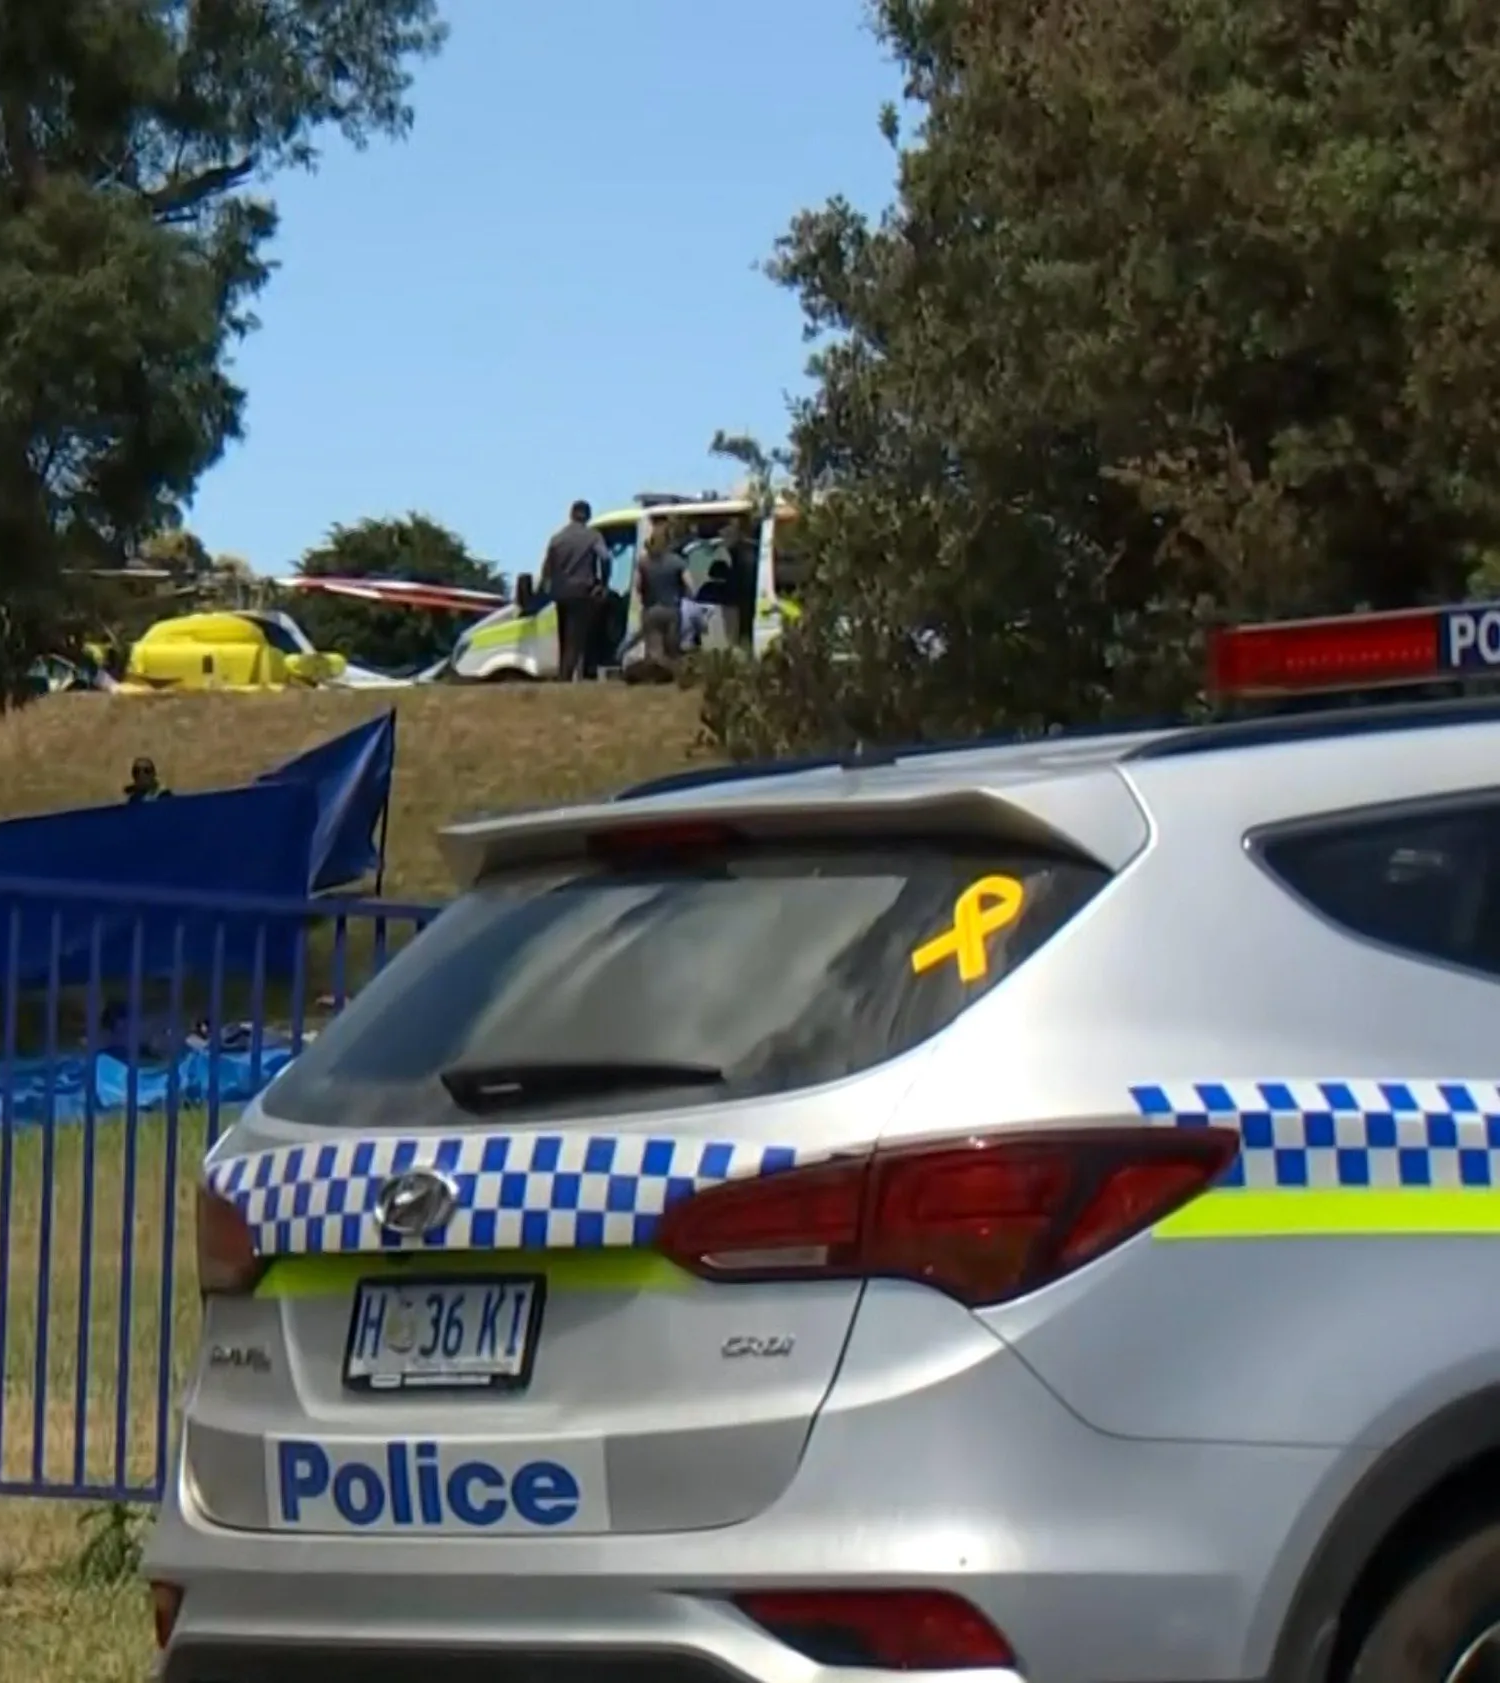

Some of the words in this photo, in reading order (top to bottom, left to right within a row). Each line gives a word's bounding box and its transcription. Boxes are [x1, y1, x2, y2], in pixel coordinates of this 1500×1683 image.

[1450, 610, 1500, 667] PO
[356, 1292, 387, 1359] H
[418, 1292, 465, 1359] 36
[278, 1440, 580, 1526] Police
